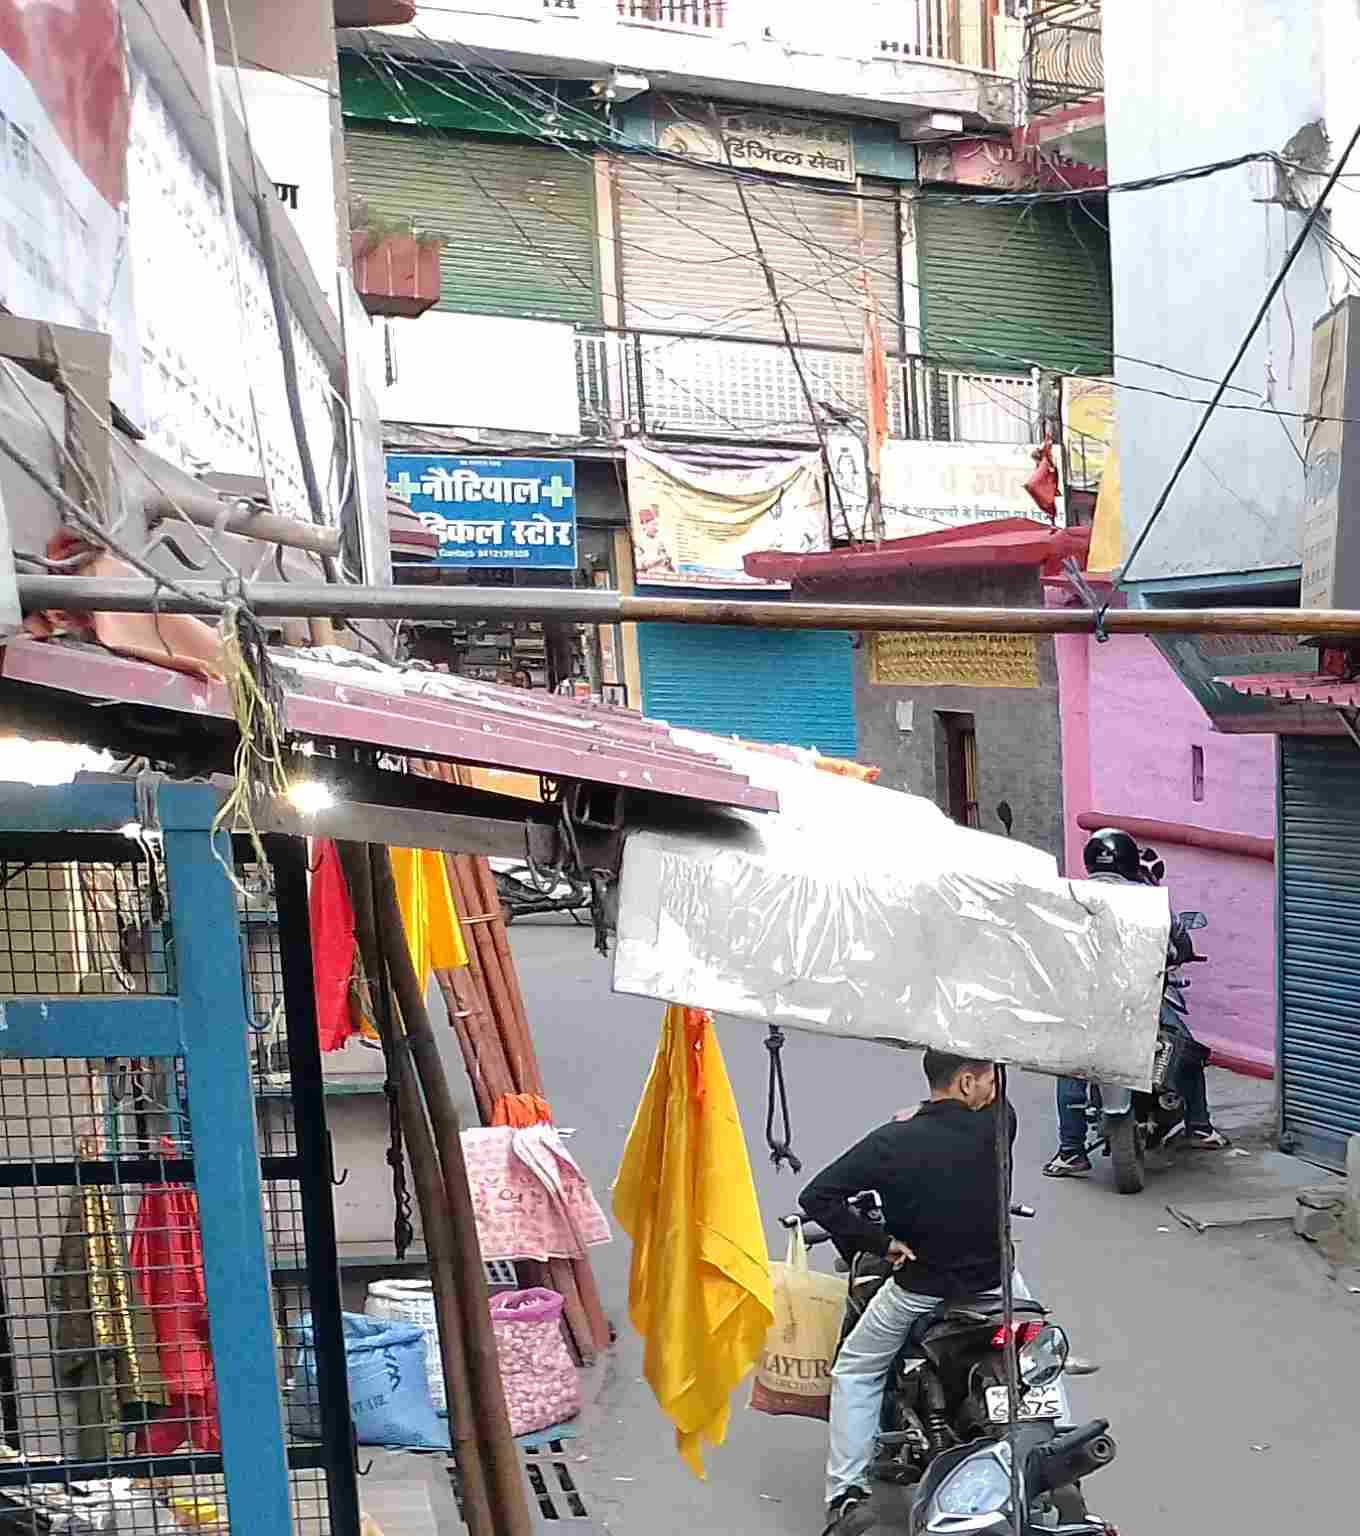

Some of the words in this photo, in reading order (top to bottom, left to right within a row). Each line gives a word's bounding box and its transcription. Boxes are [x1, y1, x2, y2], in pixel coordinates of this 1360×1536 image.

[419, 465, 542, 504] नौटियाल
[418, 511, 506, 545] डिकल
[510, 512, 573, 546] स्टोर
[992, 1400, 1060, 1418] 675
